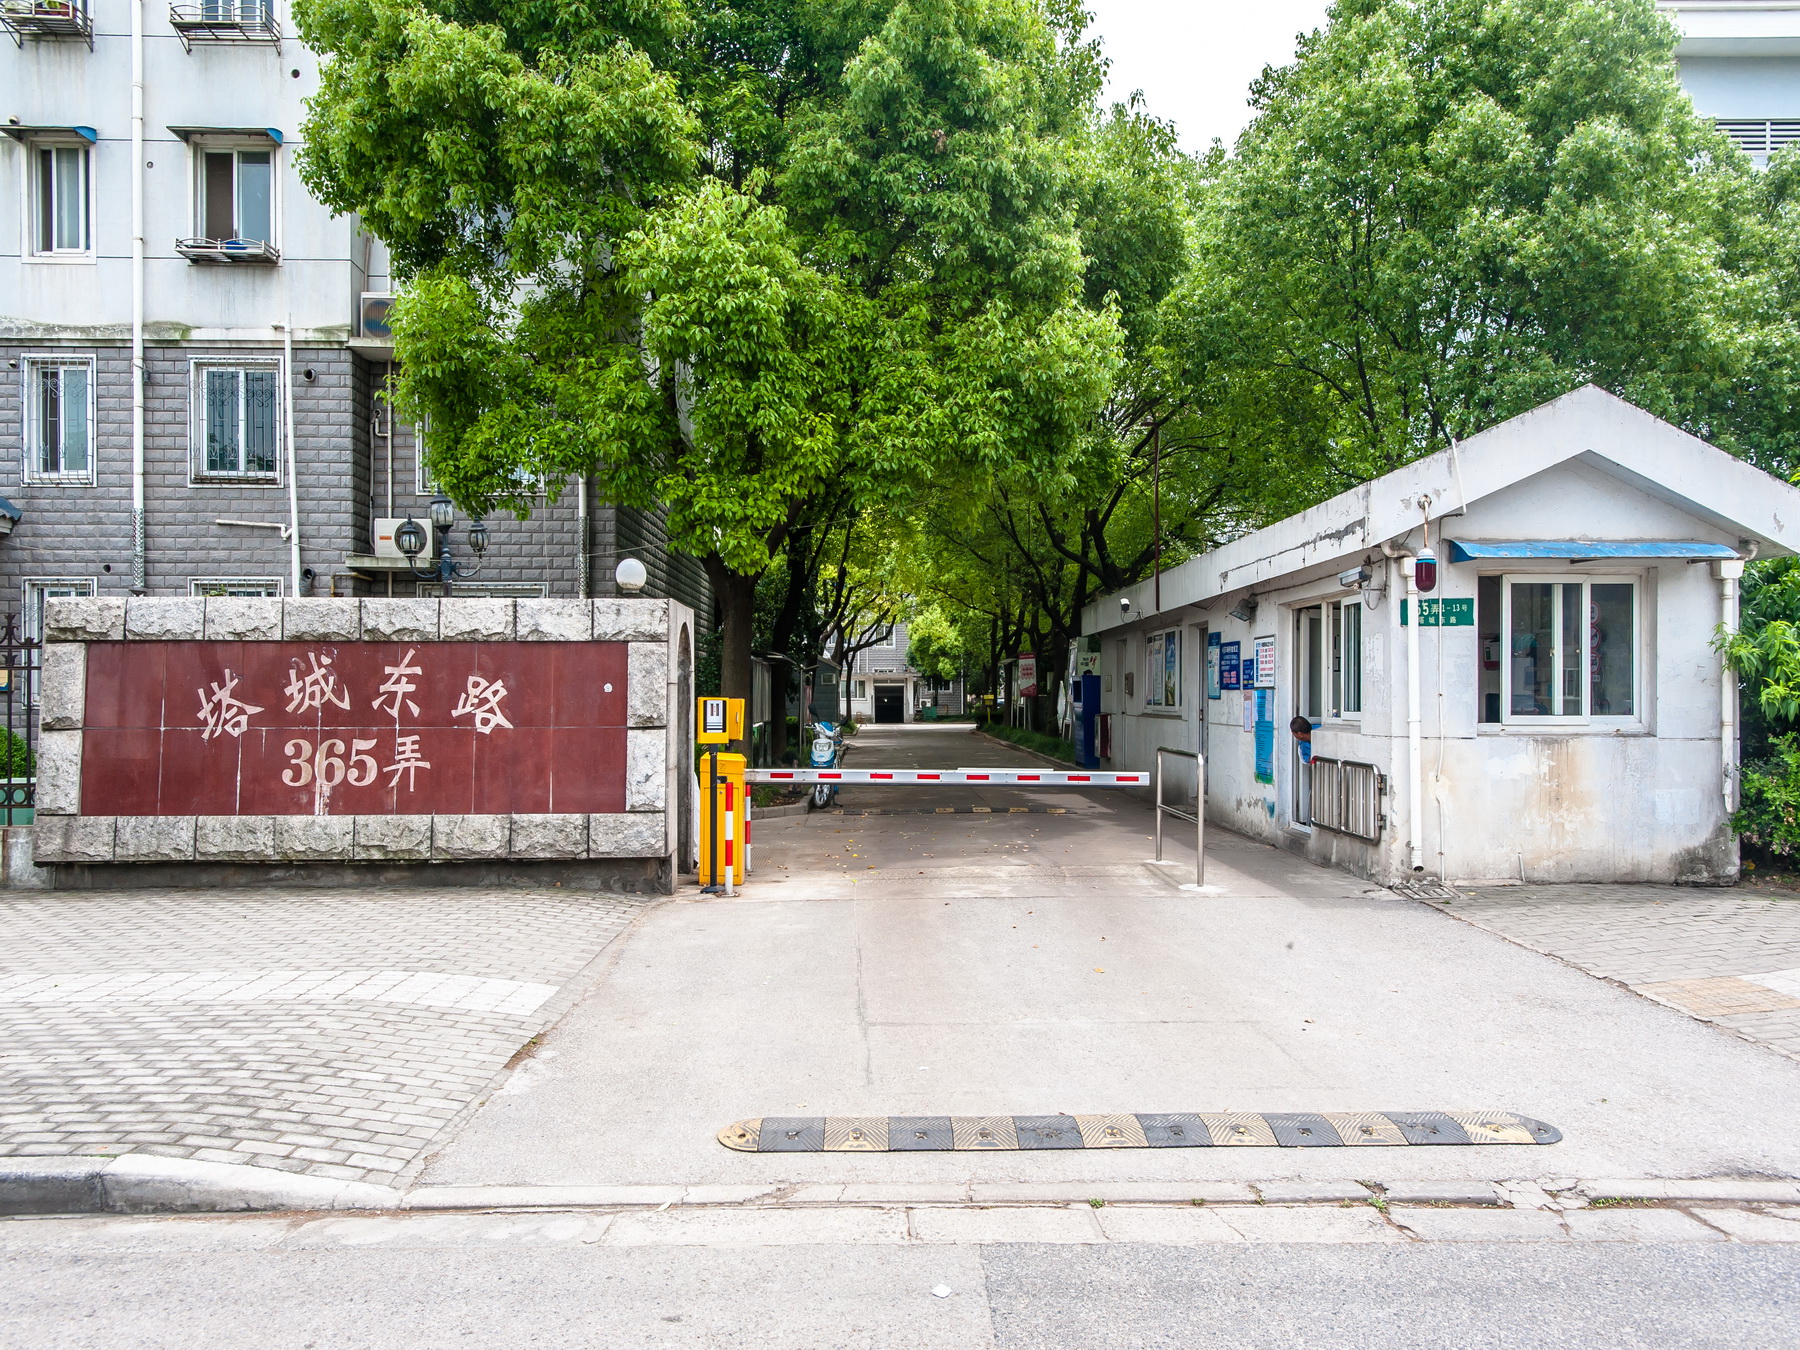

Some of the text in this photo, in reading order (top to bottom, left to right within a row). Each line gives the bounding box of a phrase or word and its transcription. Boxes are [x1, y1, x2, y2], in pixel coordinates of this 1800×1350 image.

[197, 648, 514, 738] 塔城东路
[281, 734, 431, 792] 365弄
